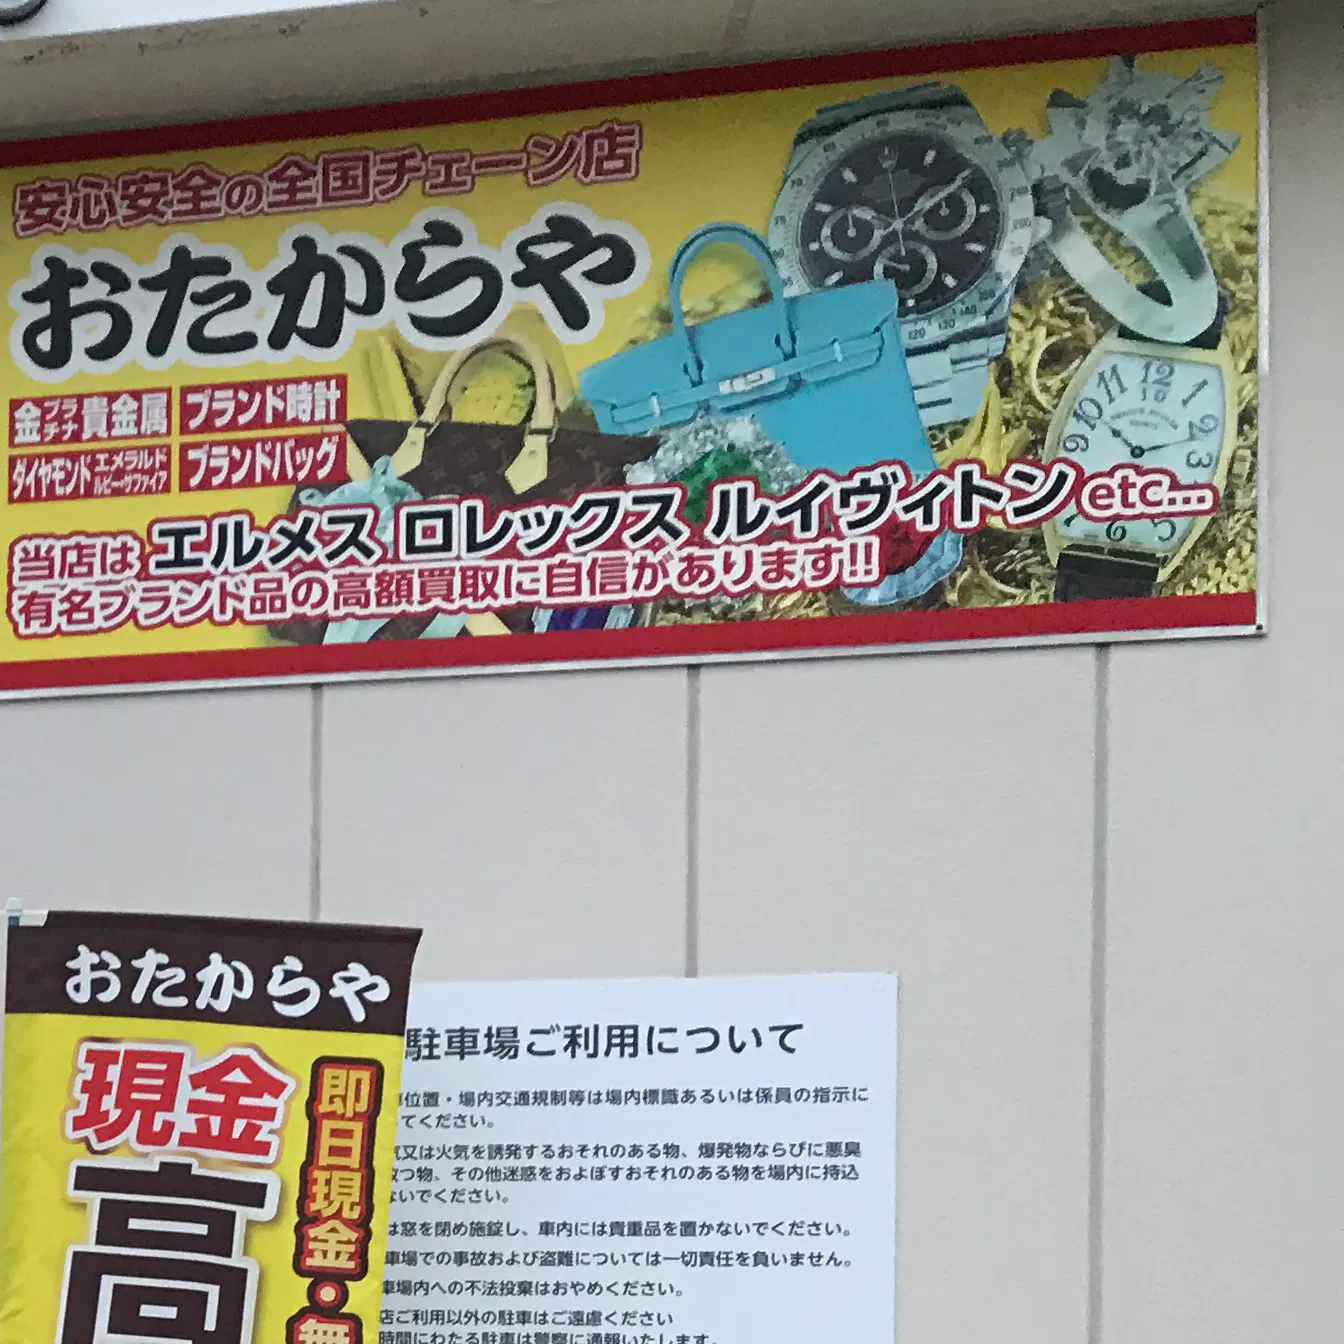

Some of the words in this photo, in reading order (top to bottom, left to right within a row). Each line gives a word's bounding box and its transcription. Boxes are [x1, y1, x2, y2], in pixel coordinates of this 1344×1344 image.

[16, 122, 640, 236] 安心安全の全国チェーン店
[21, 213, 637, 371] おたからや
[185, 378, 341, 430] ブランド時計
[11, 456, 92, 500] ダイヤモンド
[94, 446, 168, 473] エメラルド
[186, 434, 340, 489] ブランドバッグ
[17, 539, 141, 583] 当店は
[149, 510, 379, 574] エルメス
[406, 488, 685, 559] ロレックス
[710, 464, 1073, 540] ルイヴィトン
[64, 943, 391, 1023] おたからや
[405, 1022, 804, 1061] 駐車場ご利用について
[70, 1044, 290, 1158] 現金
[399, 1086, 869, 1109] 位置・場内交通規制等は場内標識あるいは係員の指示に
[399, 1113, 494, 1129] てください。
